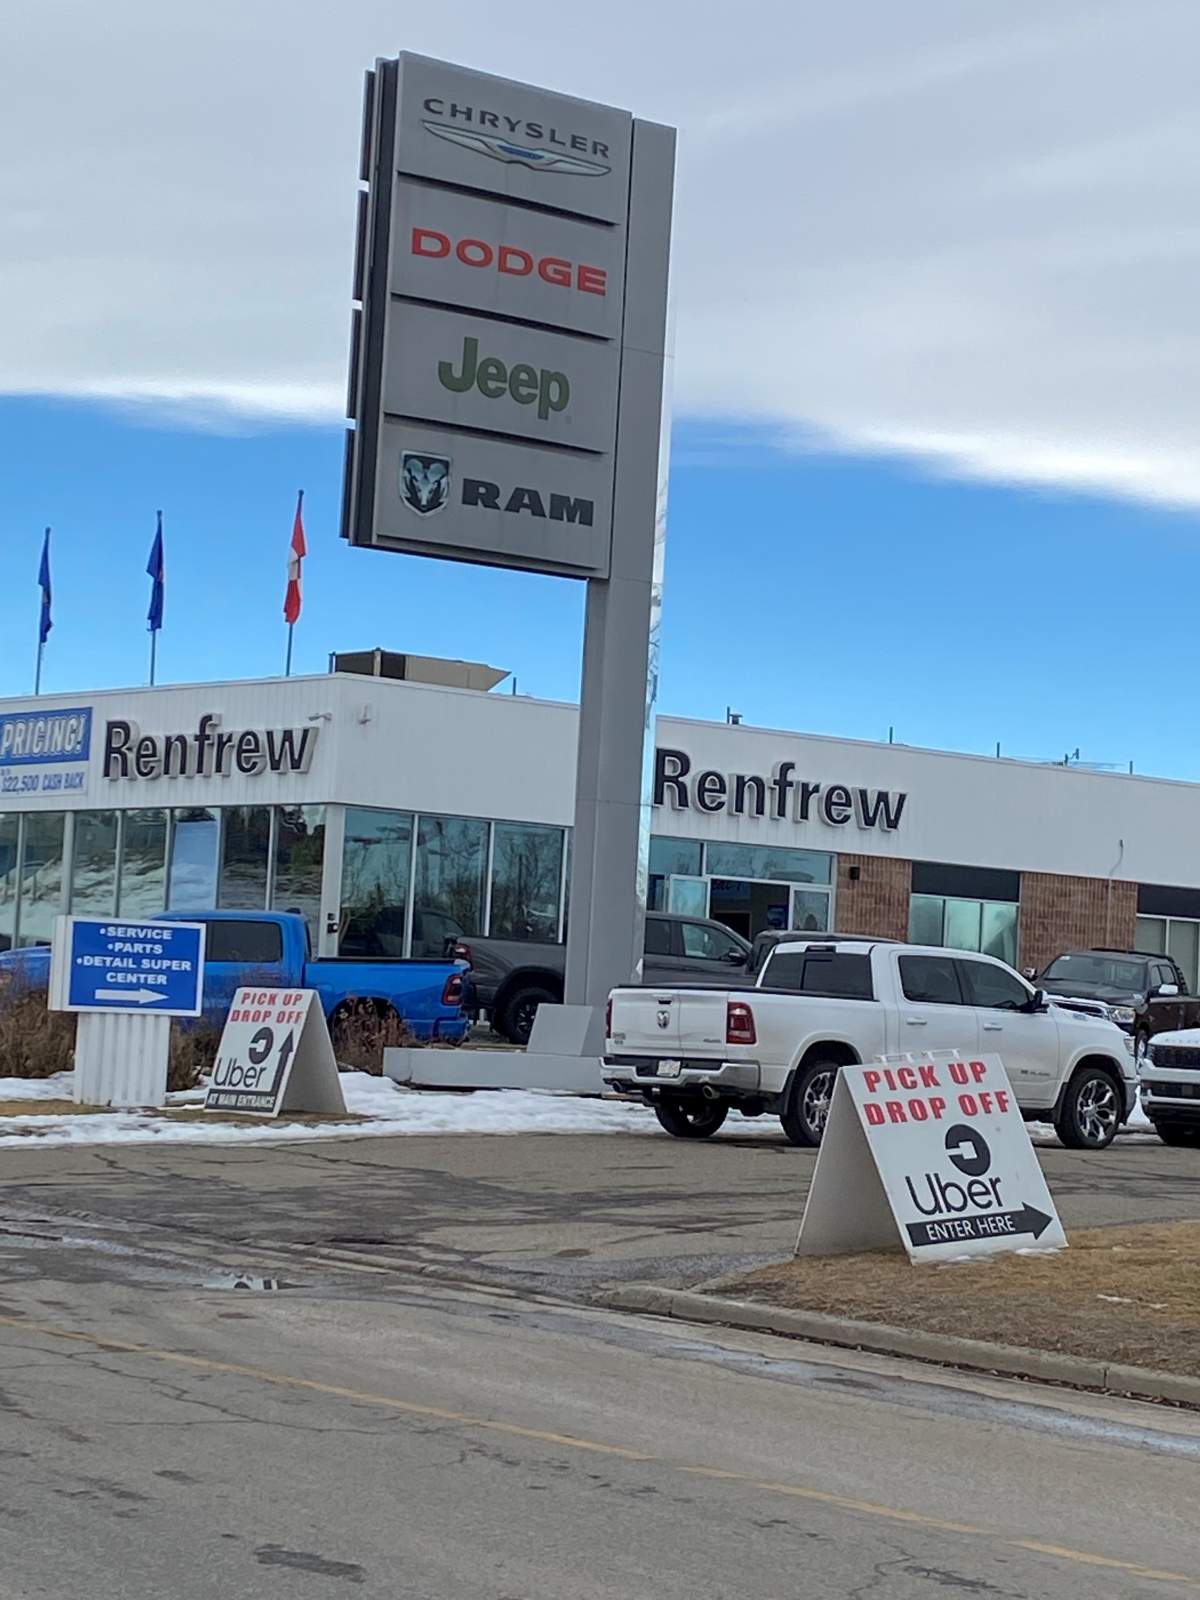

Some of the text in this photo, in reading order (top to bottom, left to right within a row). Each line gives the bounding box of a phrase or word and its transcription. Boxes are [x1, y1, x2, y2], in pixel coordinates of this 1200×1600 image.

[423, 98, 610, 159] CHRYSLER
[411, 227, 607, 297] DODGE
[438, 336, 570, 420] Jeep
[461, 478, 594, 527] RAM
[0, 714, 87, 759] PRICING!
[103, 713, 317, 780] Renfrew
[653, 747, 908, 831] Renfrew
[106, 926, 173, 940] SERVICE
[113, 942, 163, 954] PARTS
[83, 955, 192, 971] DETAIL SUPER
[106, 972, 168, 985] CENTER
[241, 992, 304, 1007] PICK UP
[229, 1010, 304, 1024] DROP OFF
[213, 1057, 267, 1088] Uber
[863, 1062, 987, 1092] PICK UP
[863, 1090, 1009, 1125] DROP OFF
[904, 1173, 1003, 1216] Uber
[926, 1214, 1016, 1241] ENTER HERE
